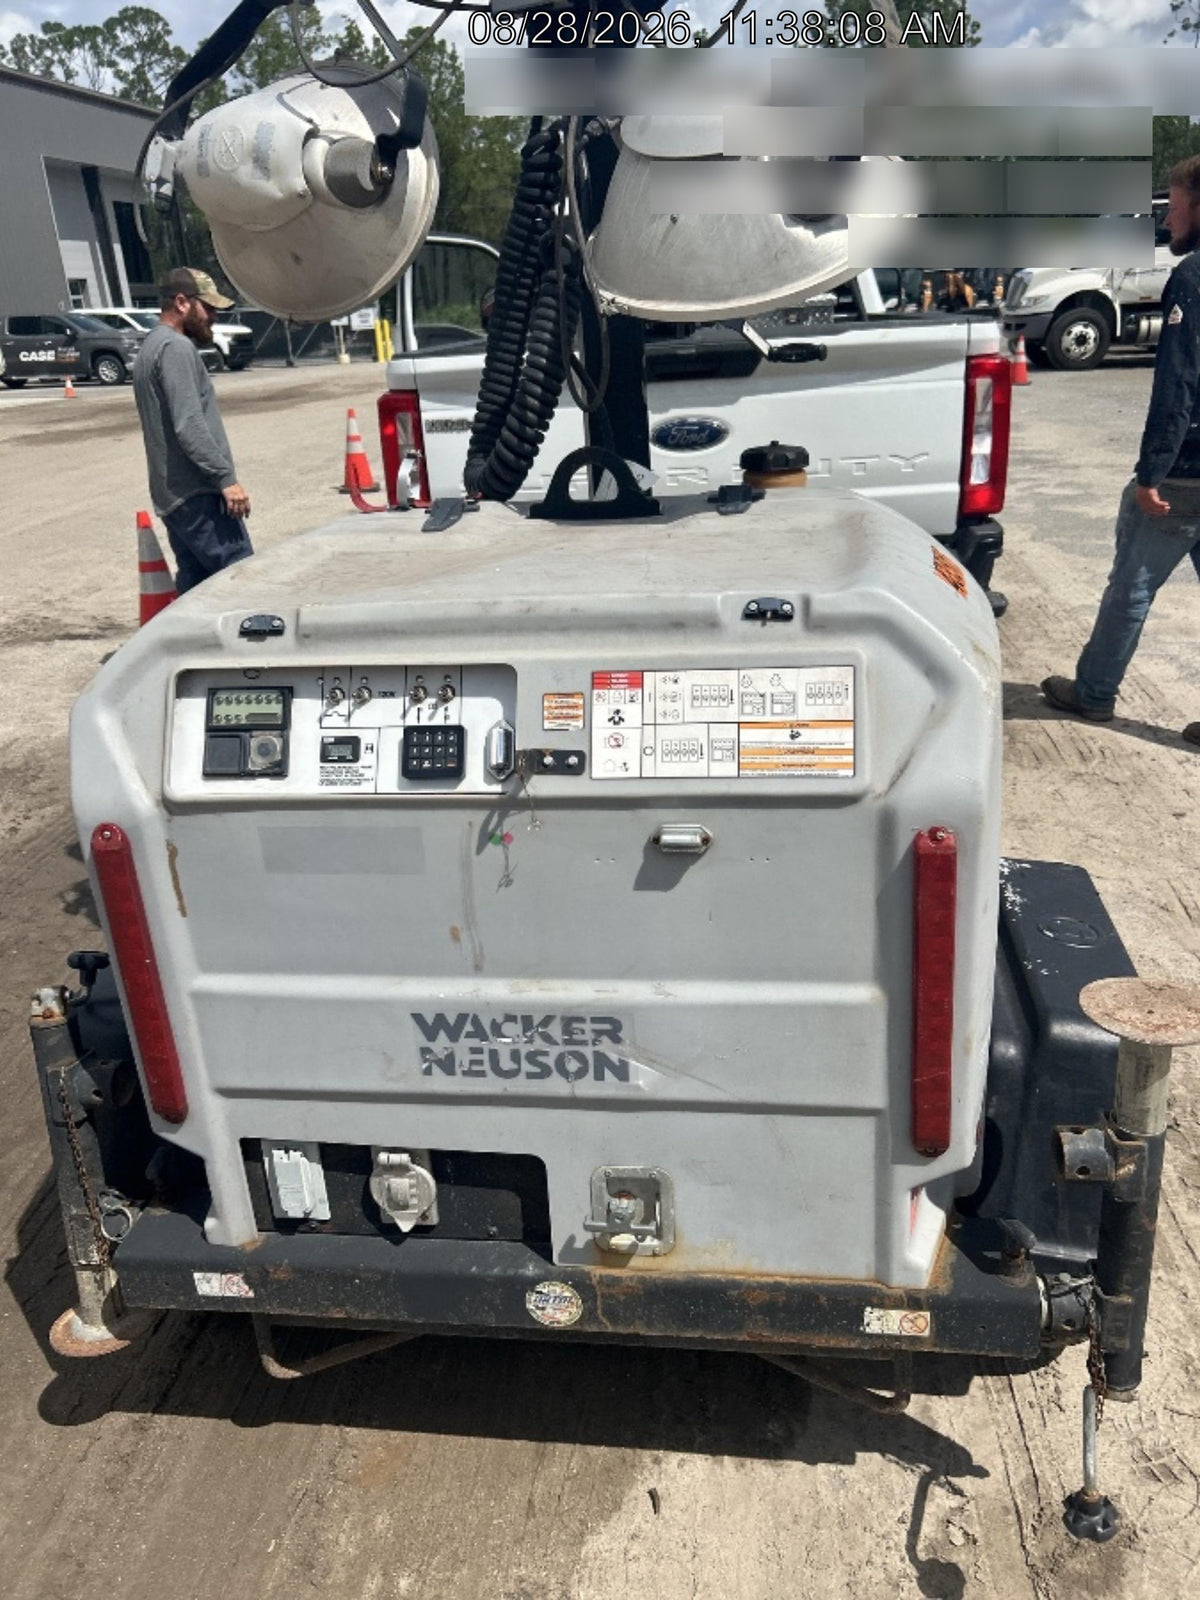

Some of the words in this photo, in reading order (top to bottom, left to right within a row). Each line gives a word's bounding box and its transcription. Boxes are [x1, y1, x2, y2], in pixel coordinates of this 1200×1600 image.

[19, 350, 56, 361] CASE
[667, 426, 710, 444] Ford
[410, 1013, 623, 1046] WACKER
[419, 1047, 631, 1082] NEUSON
